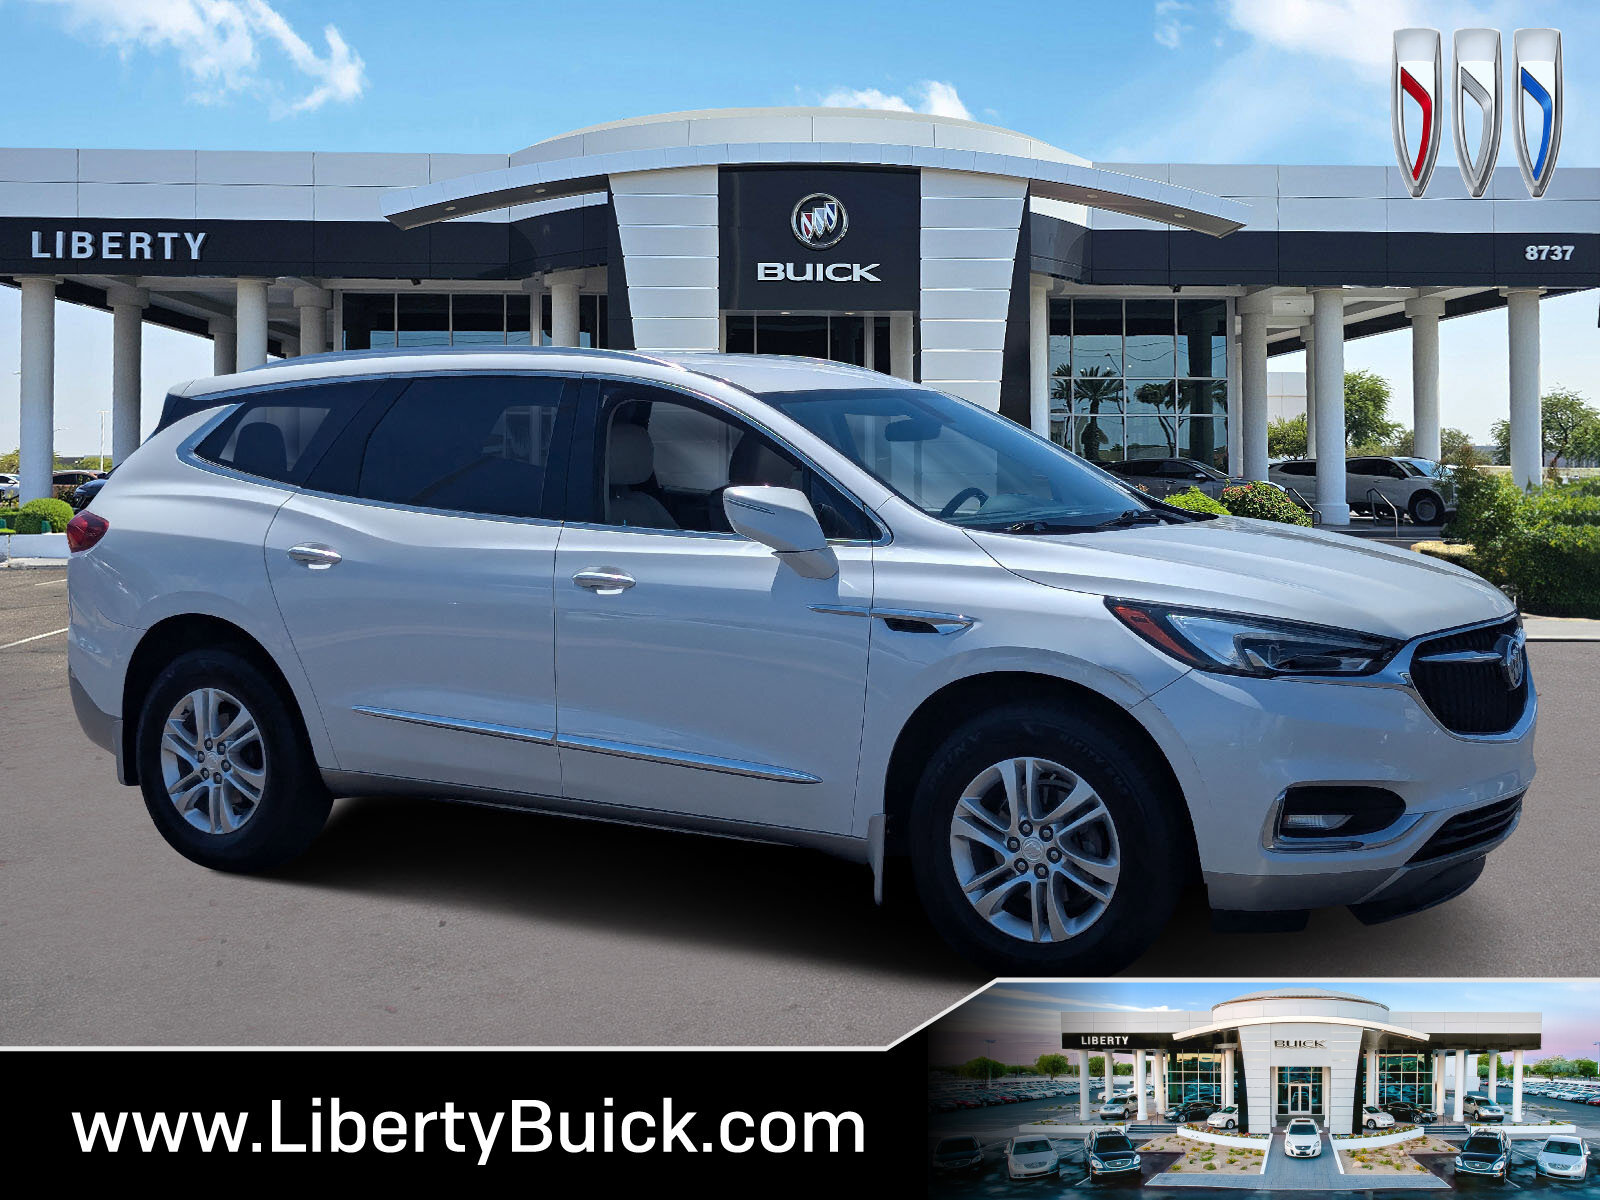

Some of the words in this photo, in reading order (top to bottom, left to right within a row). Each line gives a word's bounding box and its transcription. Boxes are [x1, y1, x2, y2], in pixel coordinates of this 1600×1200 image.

[31, 230, 206, 260] LIBERTY
[1524, 245, 1575, 261] 8737
[757, 262, 882, 282] BUICK
